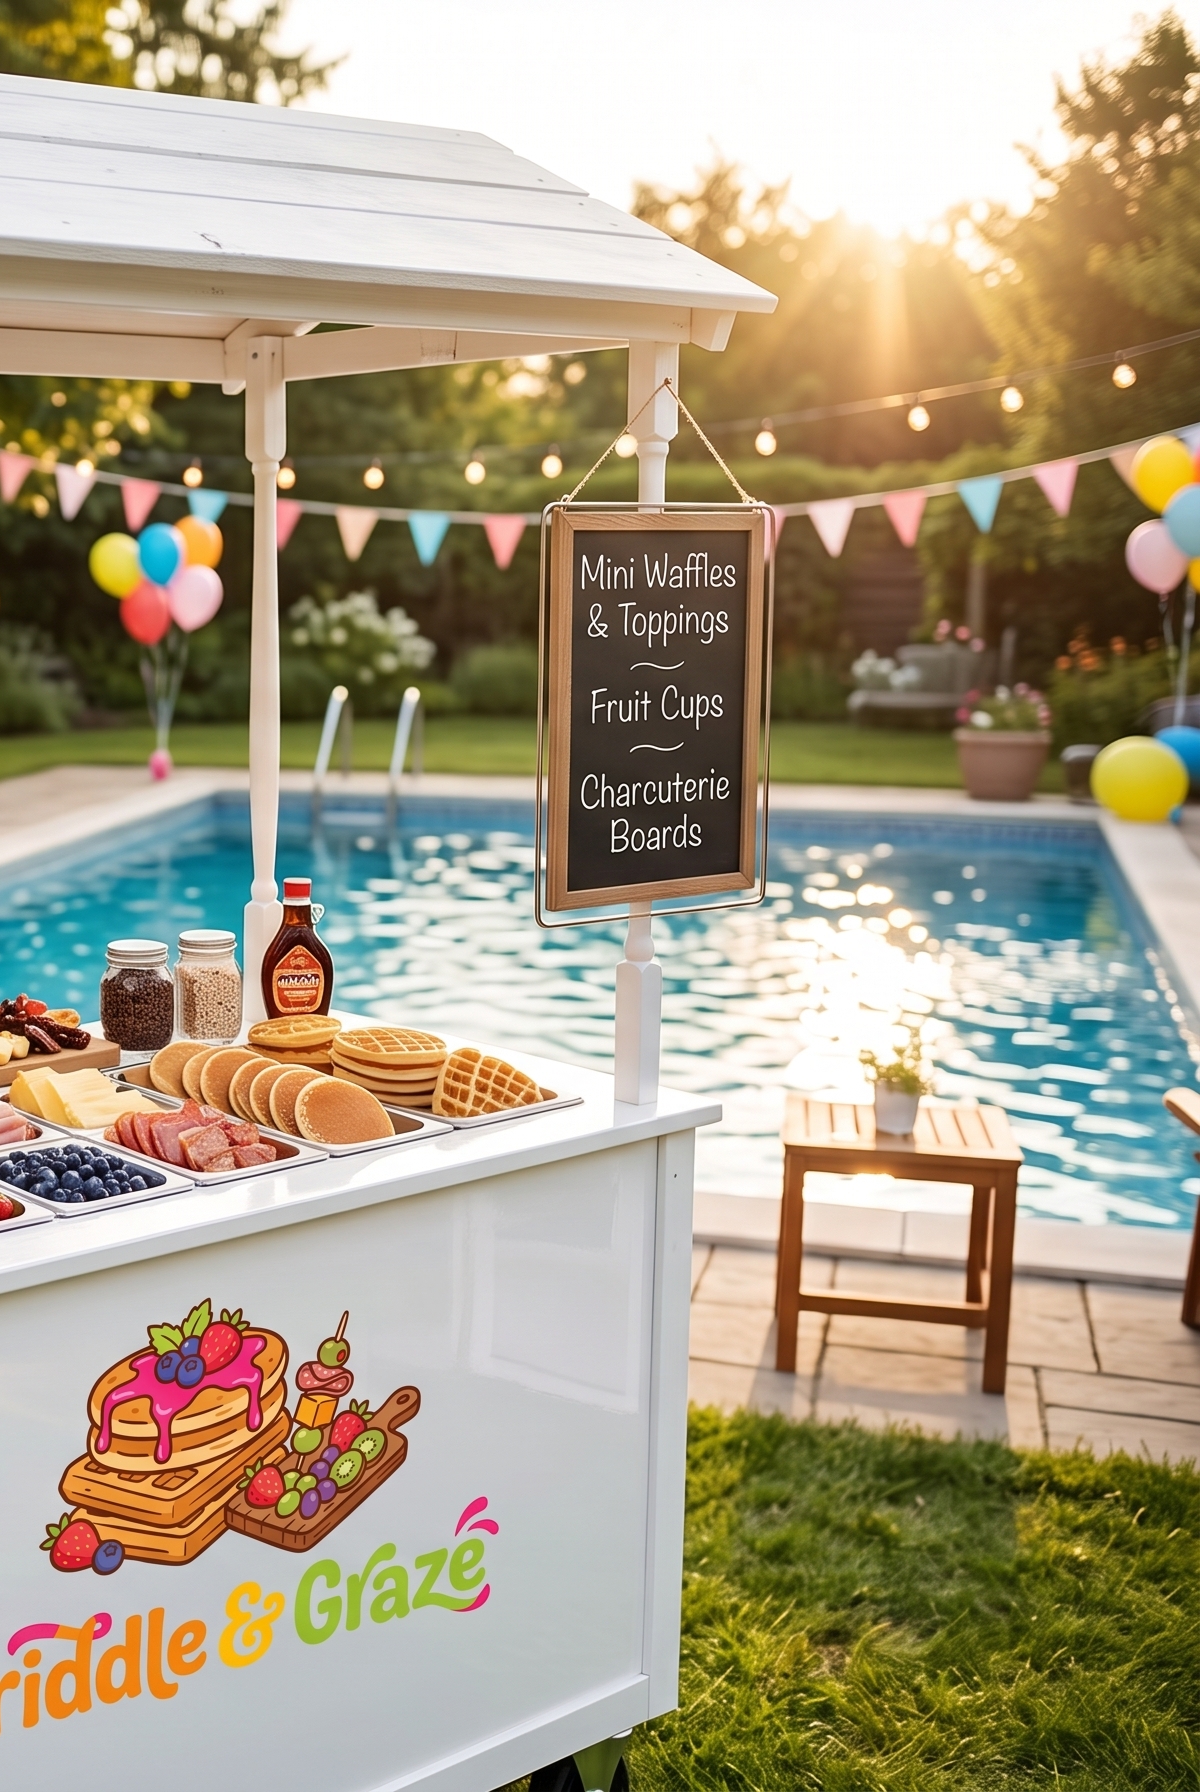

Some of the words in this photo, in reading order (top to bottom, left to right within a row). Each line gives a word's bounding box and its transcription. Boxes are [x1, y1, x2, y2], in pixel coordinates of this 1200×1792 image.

[582, 555, 634, 590] Mini
[644, 552, 736, 588] Waffles
[588, 603, 608, 638] &
[618, 602, 728, 648] Toppings
[592, 688, 651, 723] Fruit
[662, 685, 723, 730] Cups
[581, 768, 729, 809] Charcuterie
[611, 814, 701, 853] Boards
[218, 1581, 285, 1668] &
[295, 1539, 485, 1644] Graze
